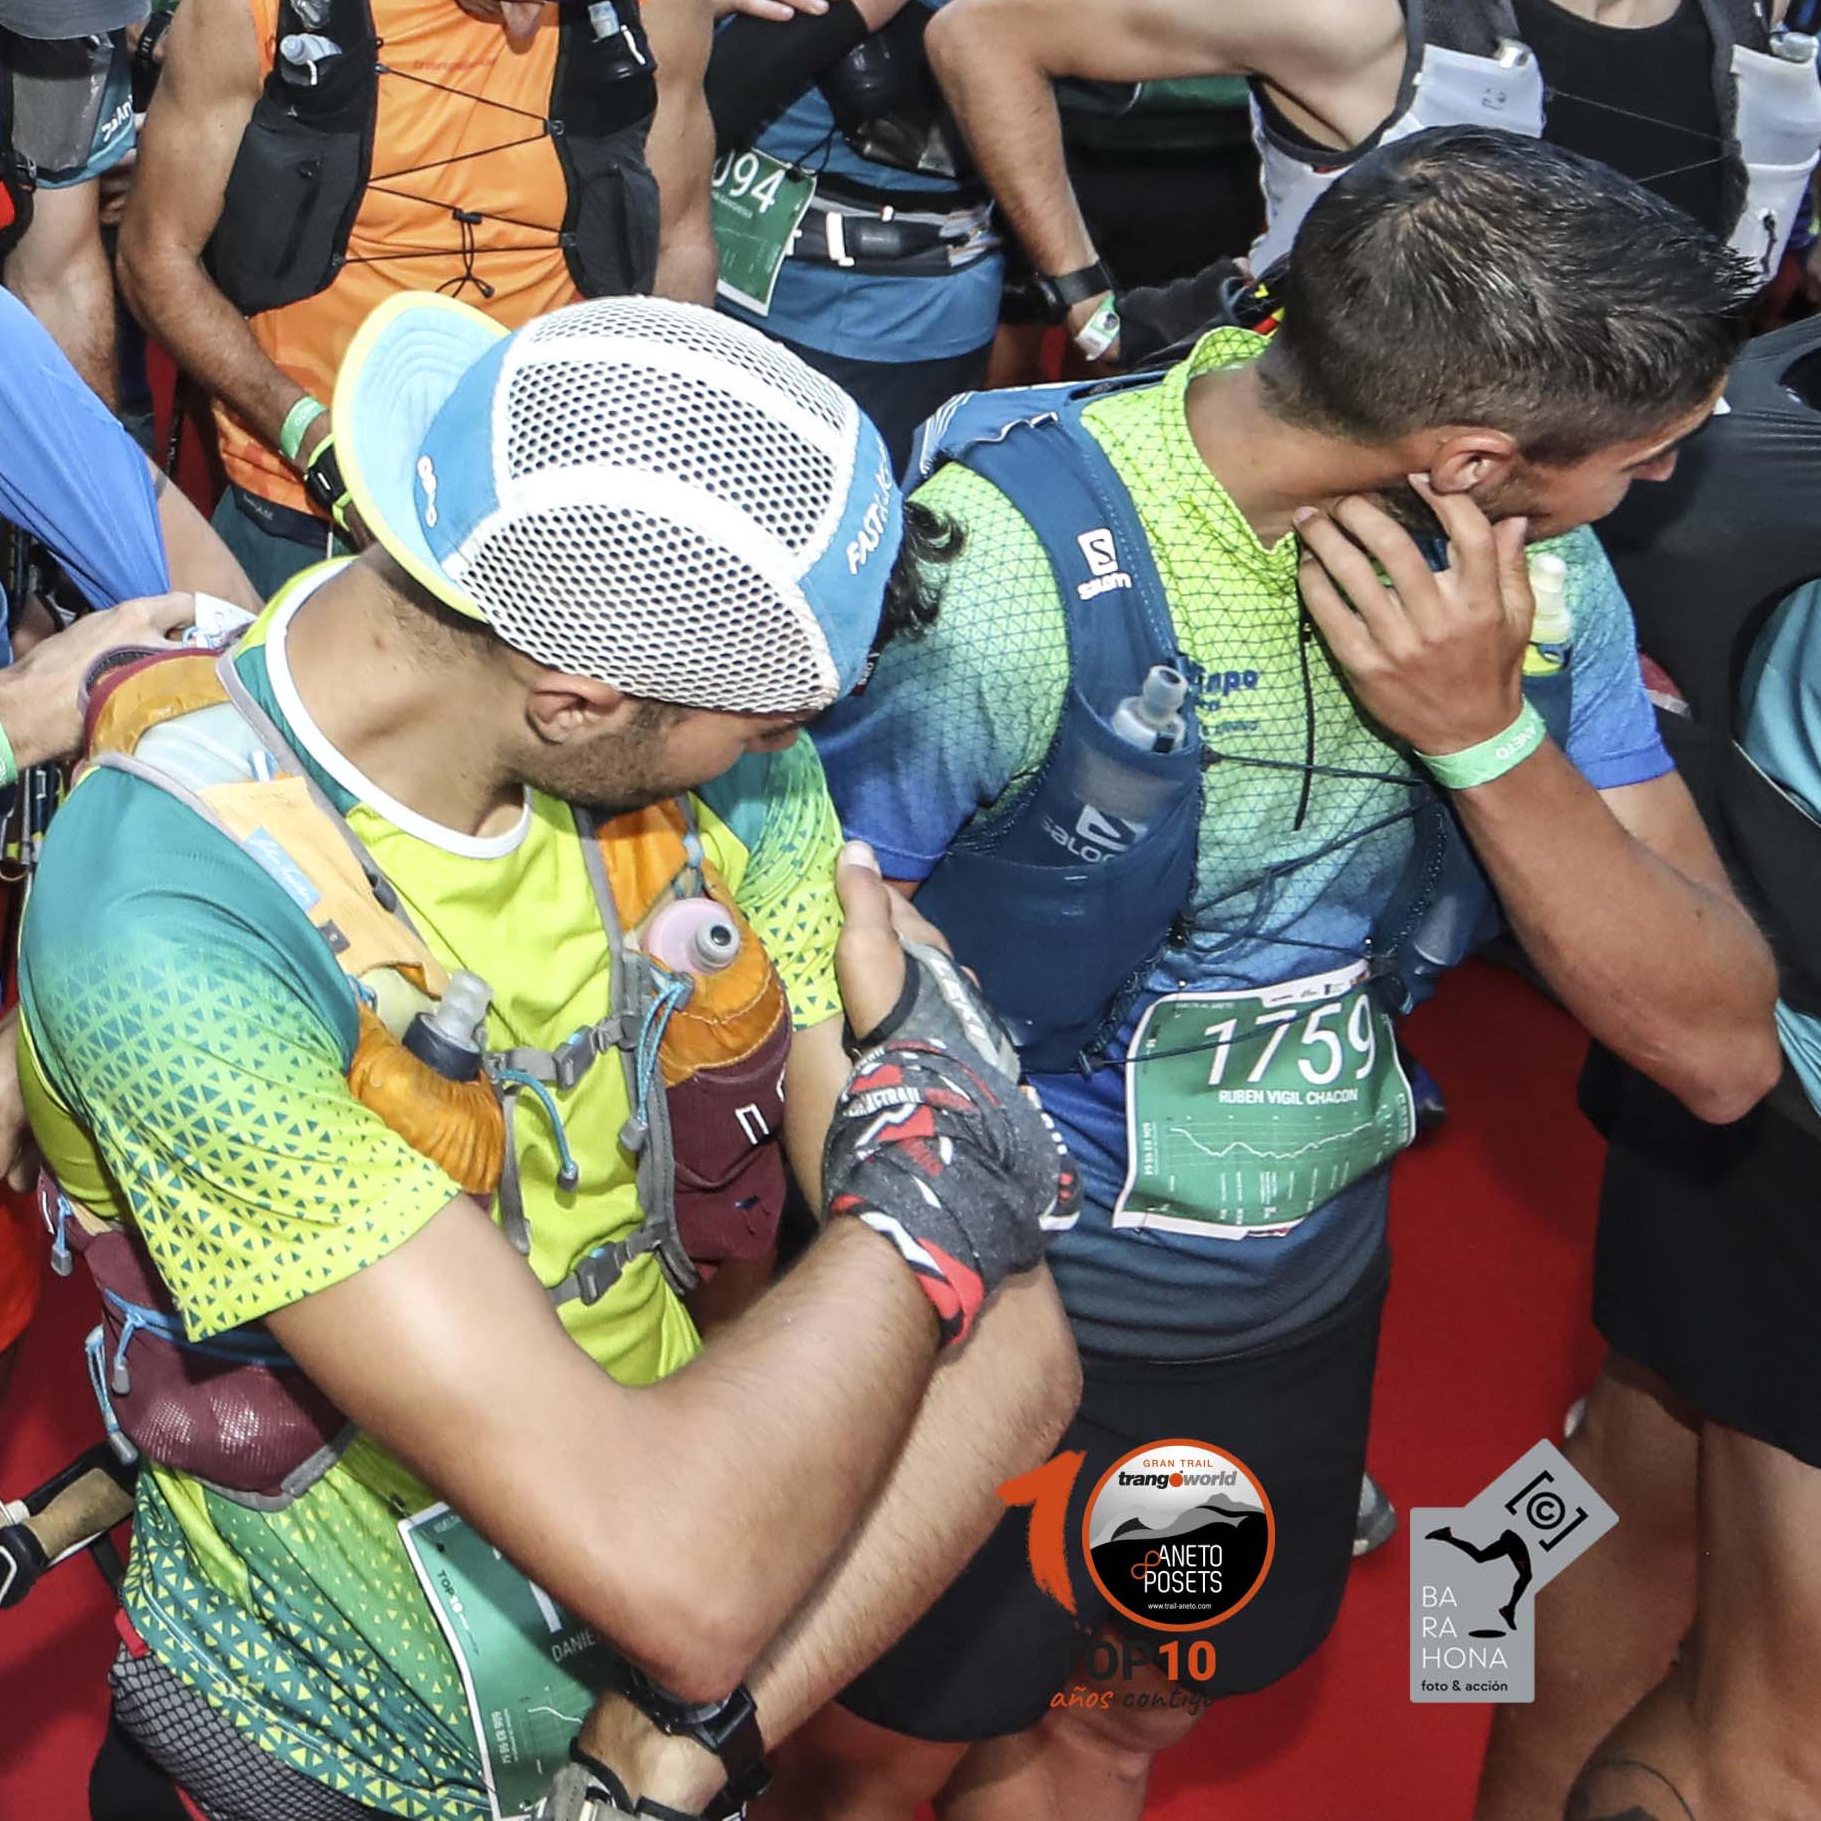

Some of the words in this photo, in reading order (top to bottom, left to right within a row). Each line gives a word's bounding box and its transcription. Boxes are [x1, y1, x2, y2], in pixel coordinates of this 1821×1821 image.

[1204, 993, 1377, 1086] 1759
[1218, 1089, 1264, 1105] RUBEN
[1266, 1089, 1303, 1105] VIGIL
